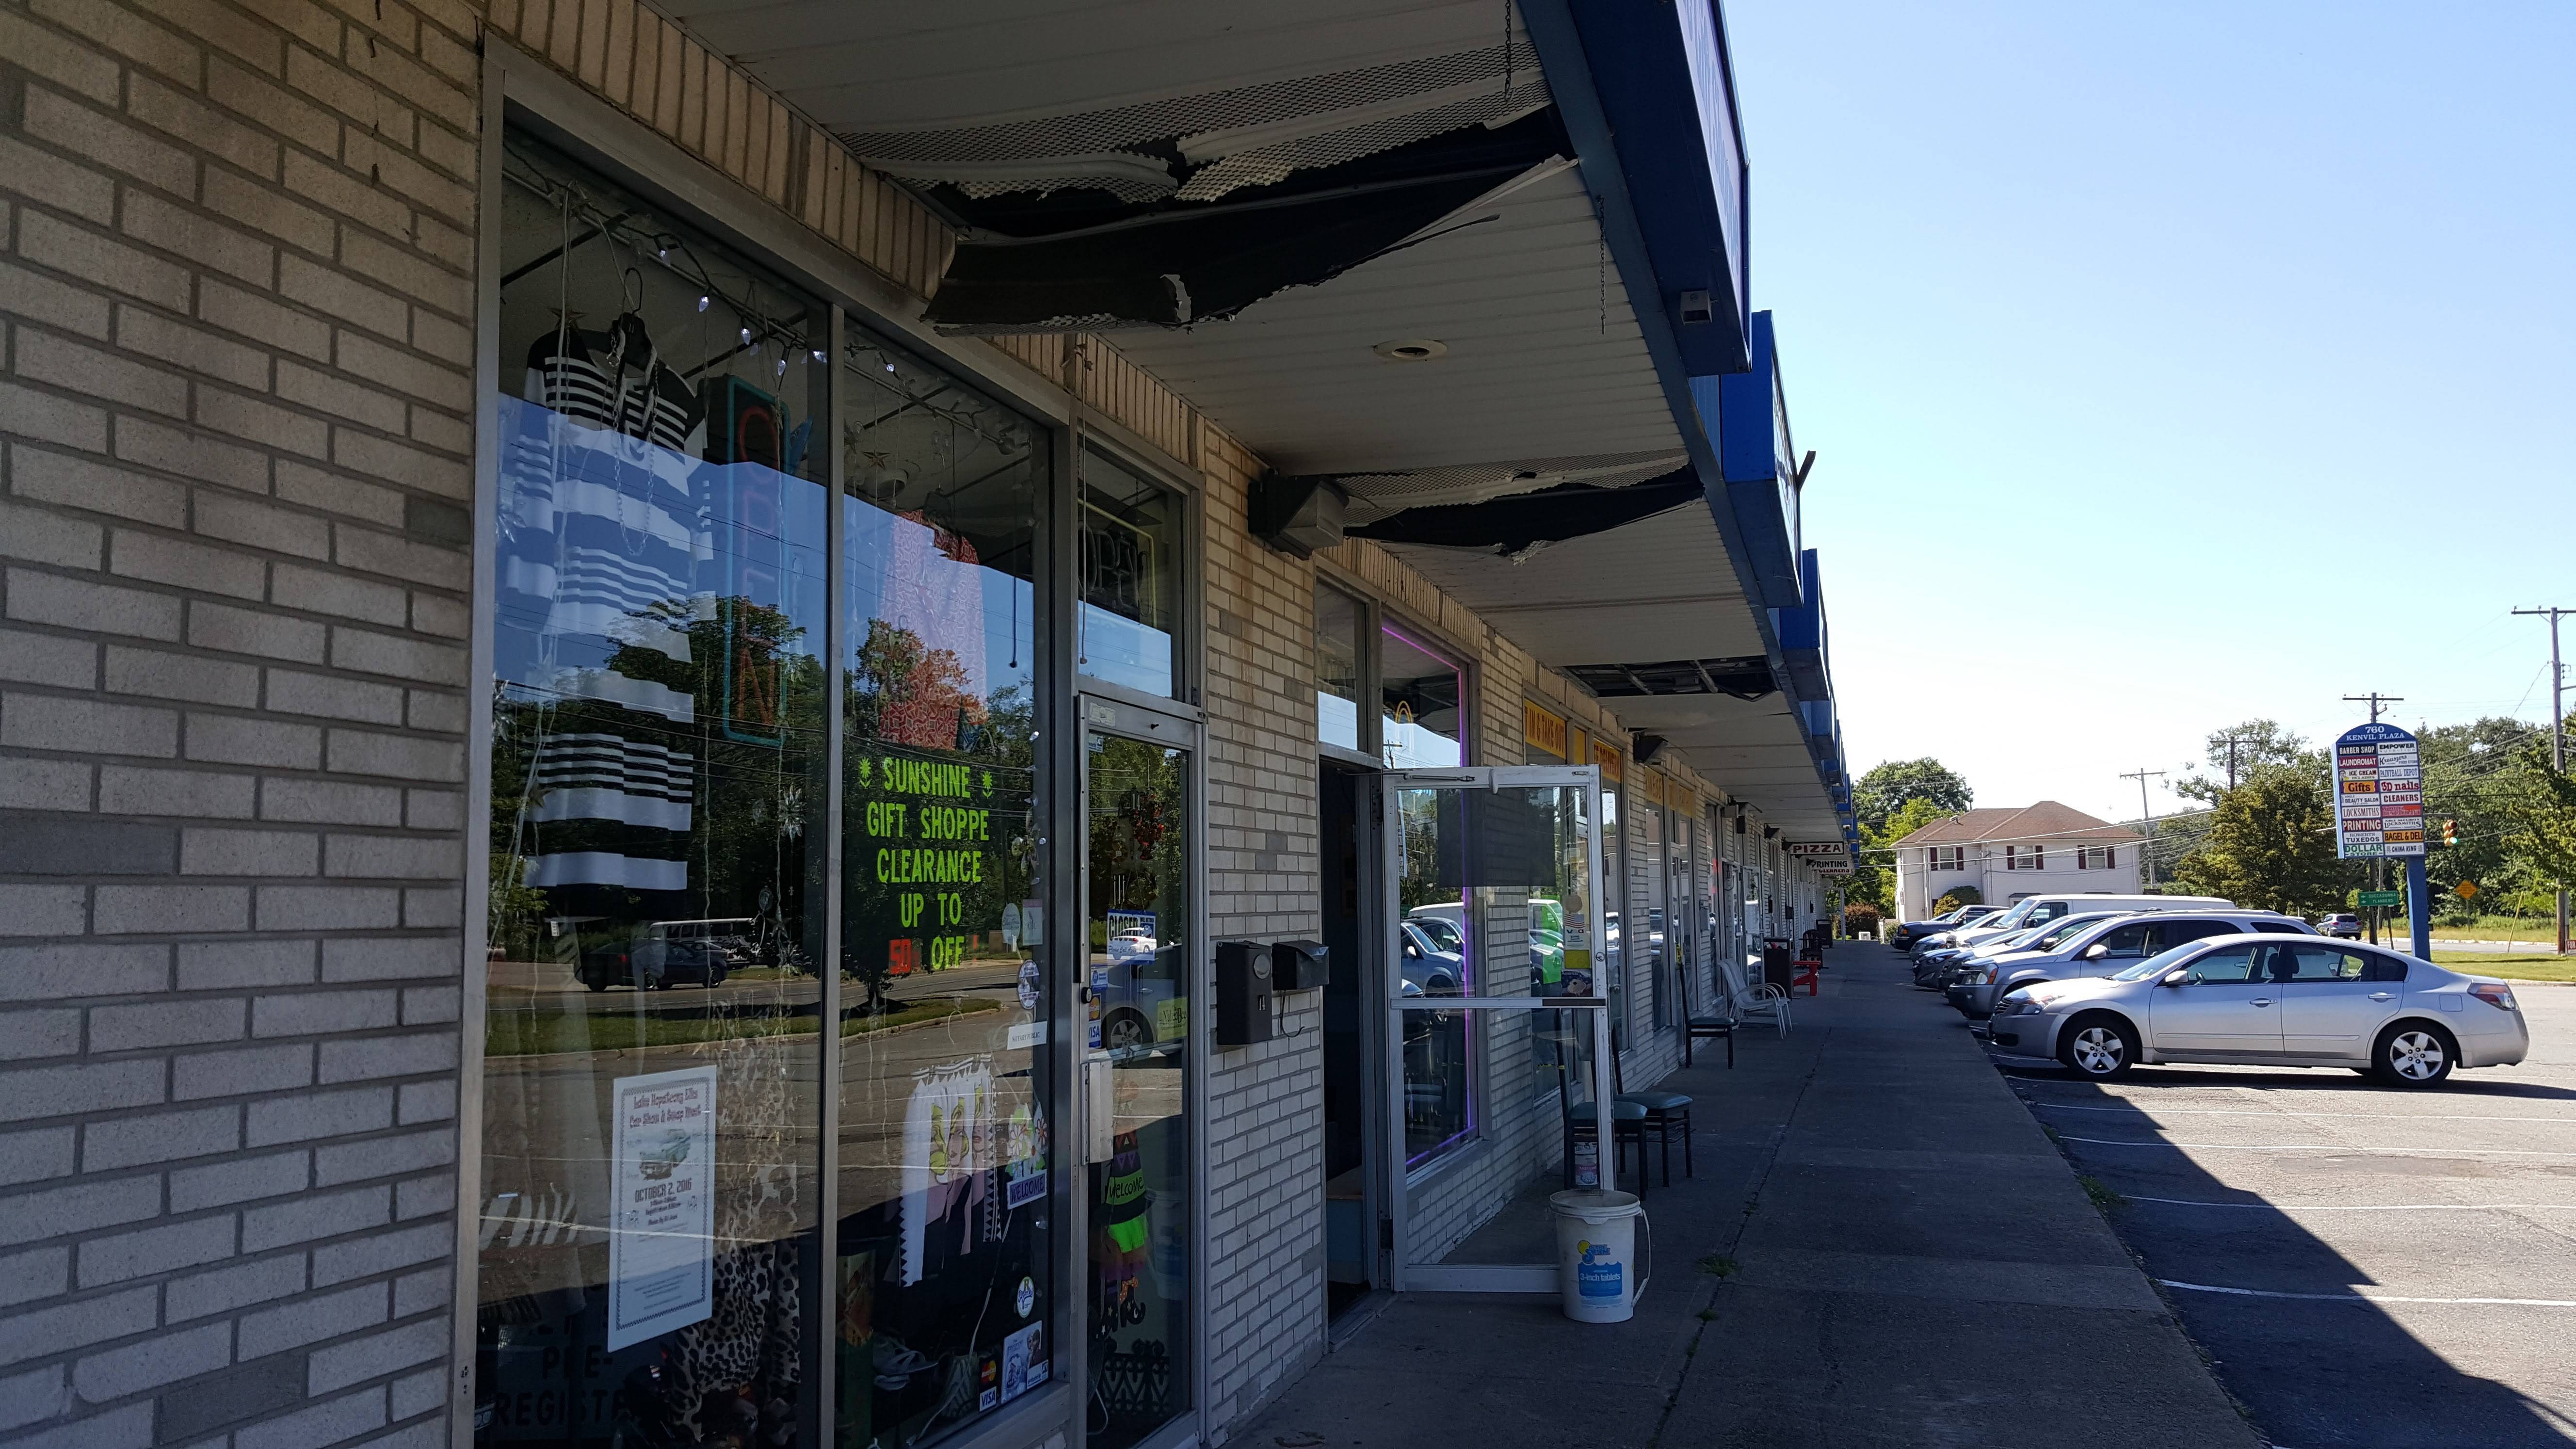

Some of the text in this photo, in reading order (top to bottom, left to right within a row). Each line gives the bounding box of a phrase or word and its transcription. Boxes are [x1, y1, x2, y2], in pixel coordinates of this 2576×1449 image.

[2339, 758, 2377, 766] LAUNDROMAT
[884, 757, 970, 798] SUNSHINE
[2380, 768, 2417, 777] PAINTBALL DEPOT
[2348, 783, 2371, 791] Gifts
[2381, 780, 2419, 791] 3D nails
[2383, 794, 2419, 803] CLEANERS
[2343, 808, 2380, 817] LOCKSMITHS
[867, 802, 989, 840] GIFT SHOPPE
[2343, 820, 2381, 831] PRINTING
[1793, 845, 1841, 853] PIZZA
[877, 848, 982, 883] CLEARANCE
[901, 893, 961, 928] UP TO
[931, 936, 965, 970] OFF
[635, 1184, 666, 1202] OCTOBER
[676, 1178, 692, 1193] 2016
[1011, 1177, 1045, 1202] WELCOME
[1579, 1272, 1621, 1281] 3-inch tablets
[981, 1392, 996, 1407] VISA
